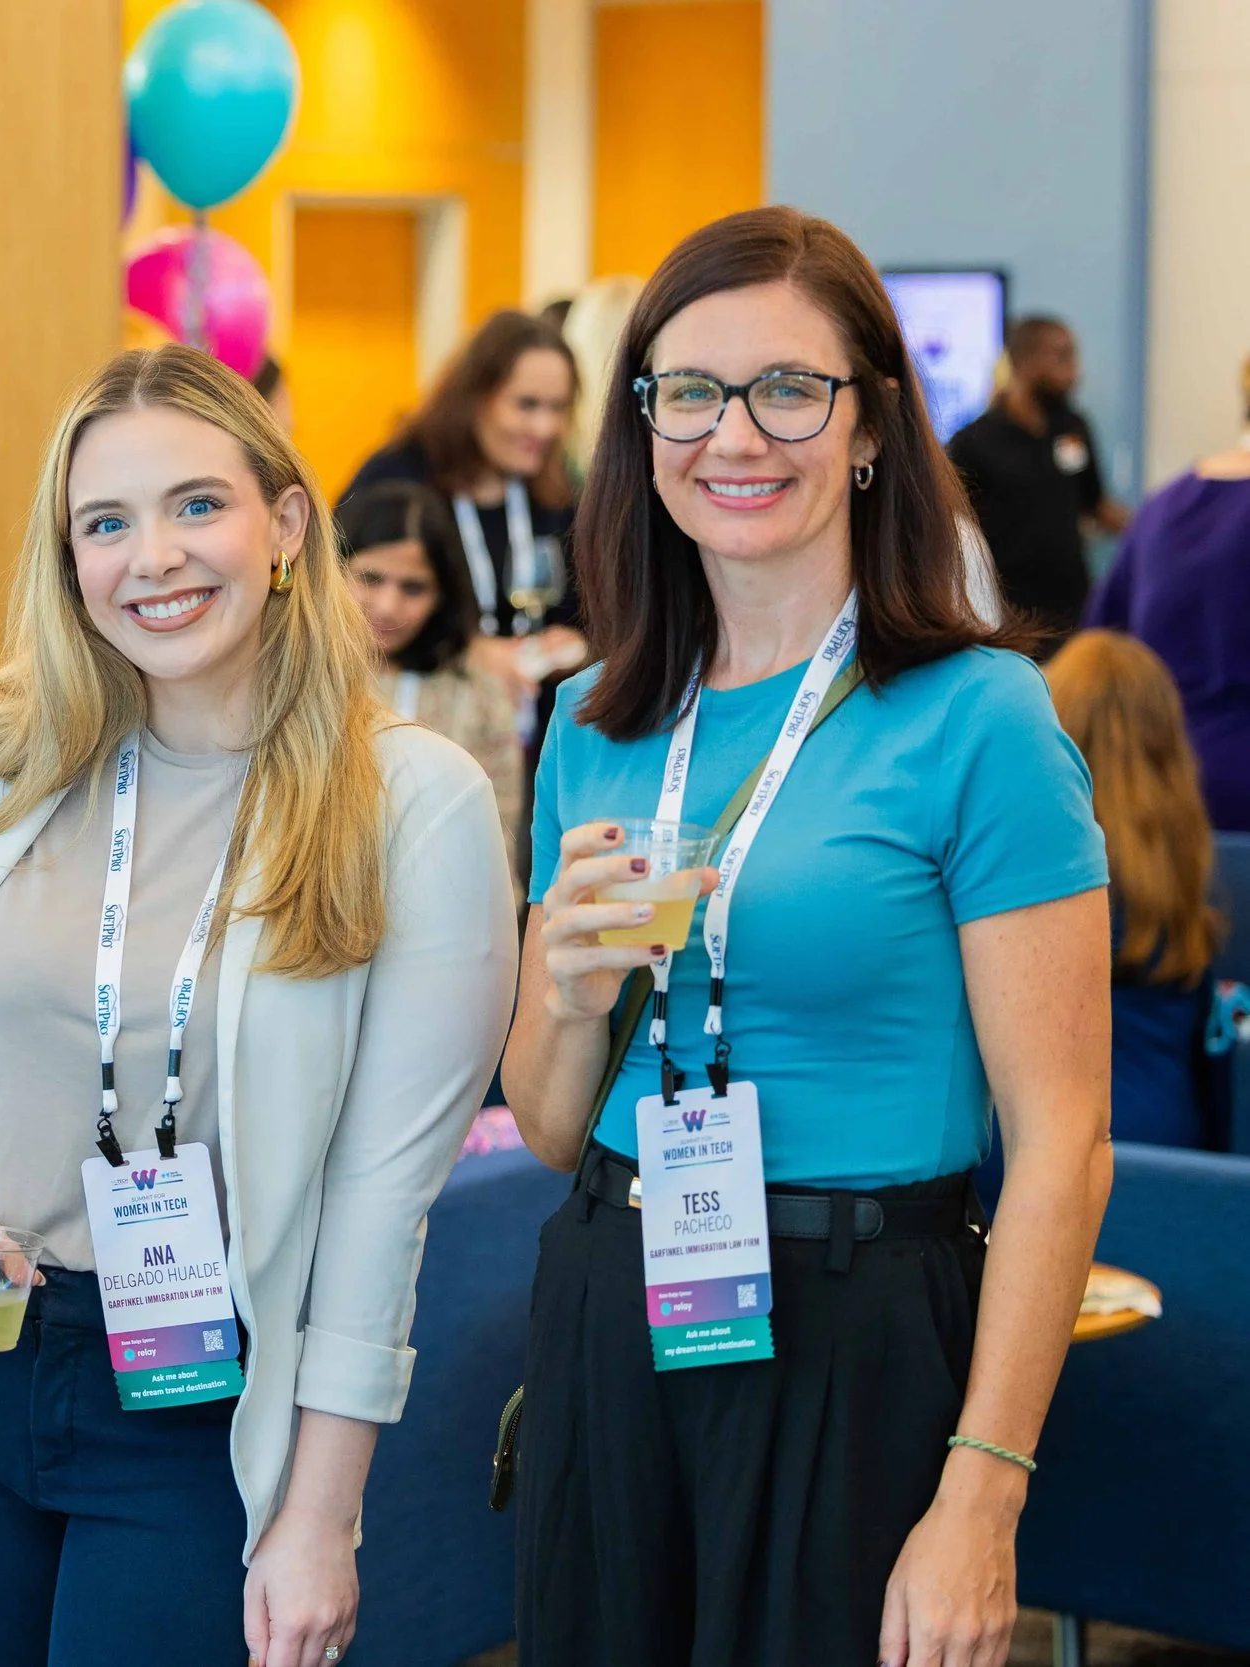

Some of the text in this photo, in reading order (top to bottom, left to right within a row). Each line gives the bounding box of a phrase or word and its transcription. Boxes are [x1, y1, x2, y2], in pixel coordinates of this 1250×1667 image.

[662, 1146, 696, 1161] WOMEN
[698, 1144, 708, 1157] IN
[710, 1140, 733, 1155] TECH
[113, 1197, 188, 1218] WOMEN IN TECH
[682, 1190, 720, 1215] TESS
[674, 1214, 732, 1236] PACHECO
[143, 1244, 176, 1268] ANA
[650, 1237, 760, 1258] GARFINKEL IMMIGRATION LAW FIRM
[103, 1261, 222, 1291] DELGADO HUALDE
[108, 1286, 224, 1309] GARFINKEL IMMIGRATION LAW FIRM
[137, 1348, 156, 1357] relay
[152, 1375, 165, 1383] Ask
[177, 1370, 198, 1379] about
[142, 1389, 164, 1397] dream
[165, 1385, 185, 1394] travel
[186, 1380, 227, 1391] destination
